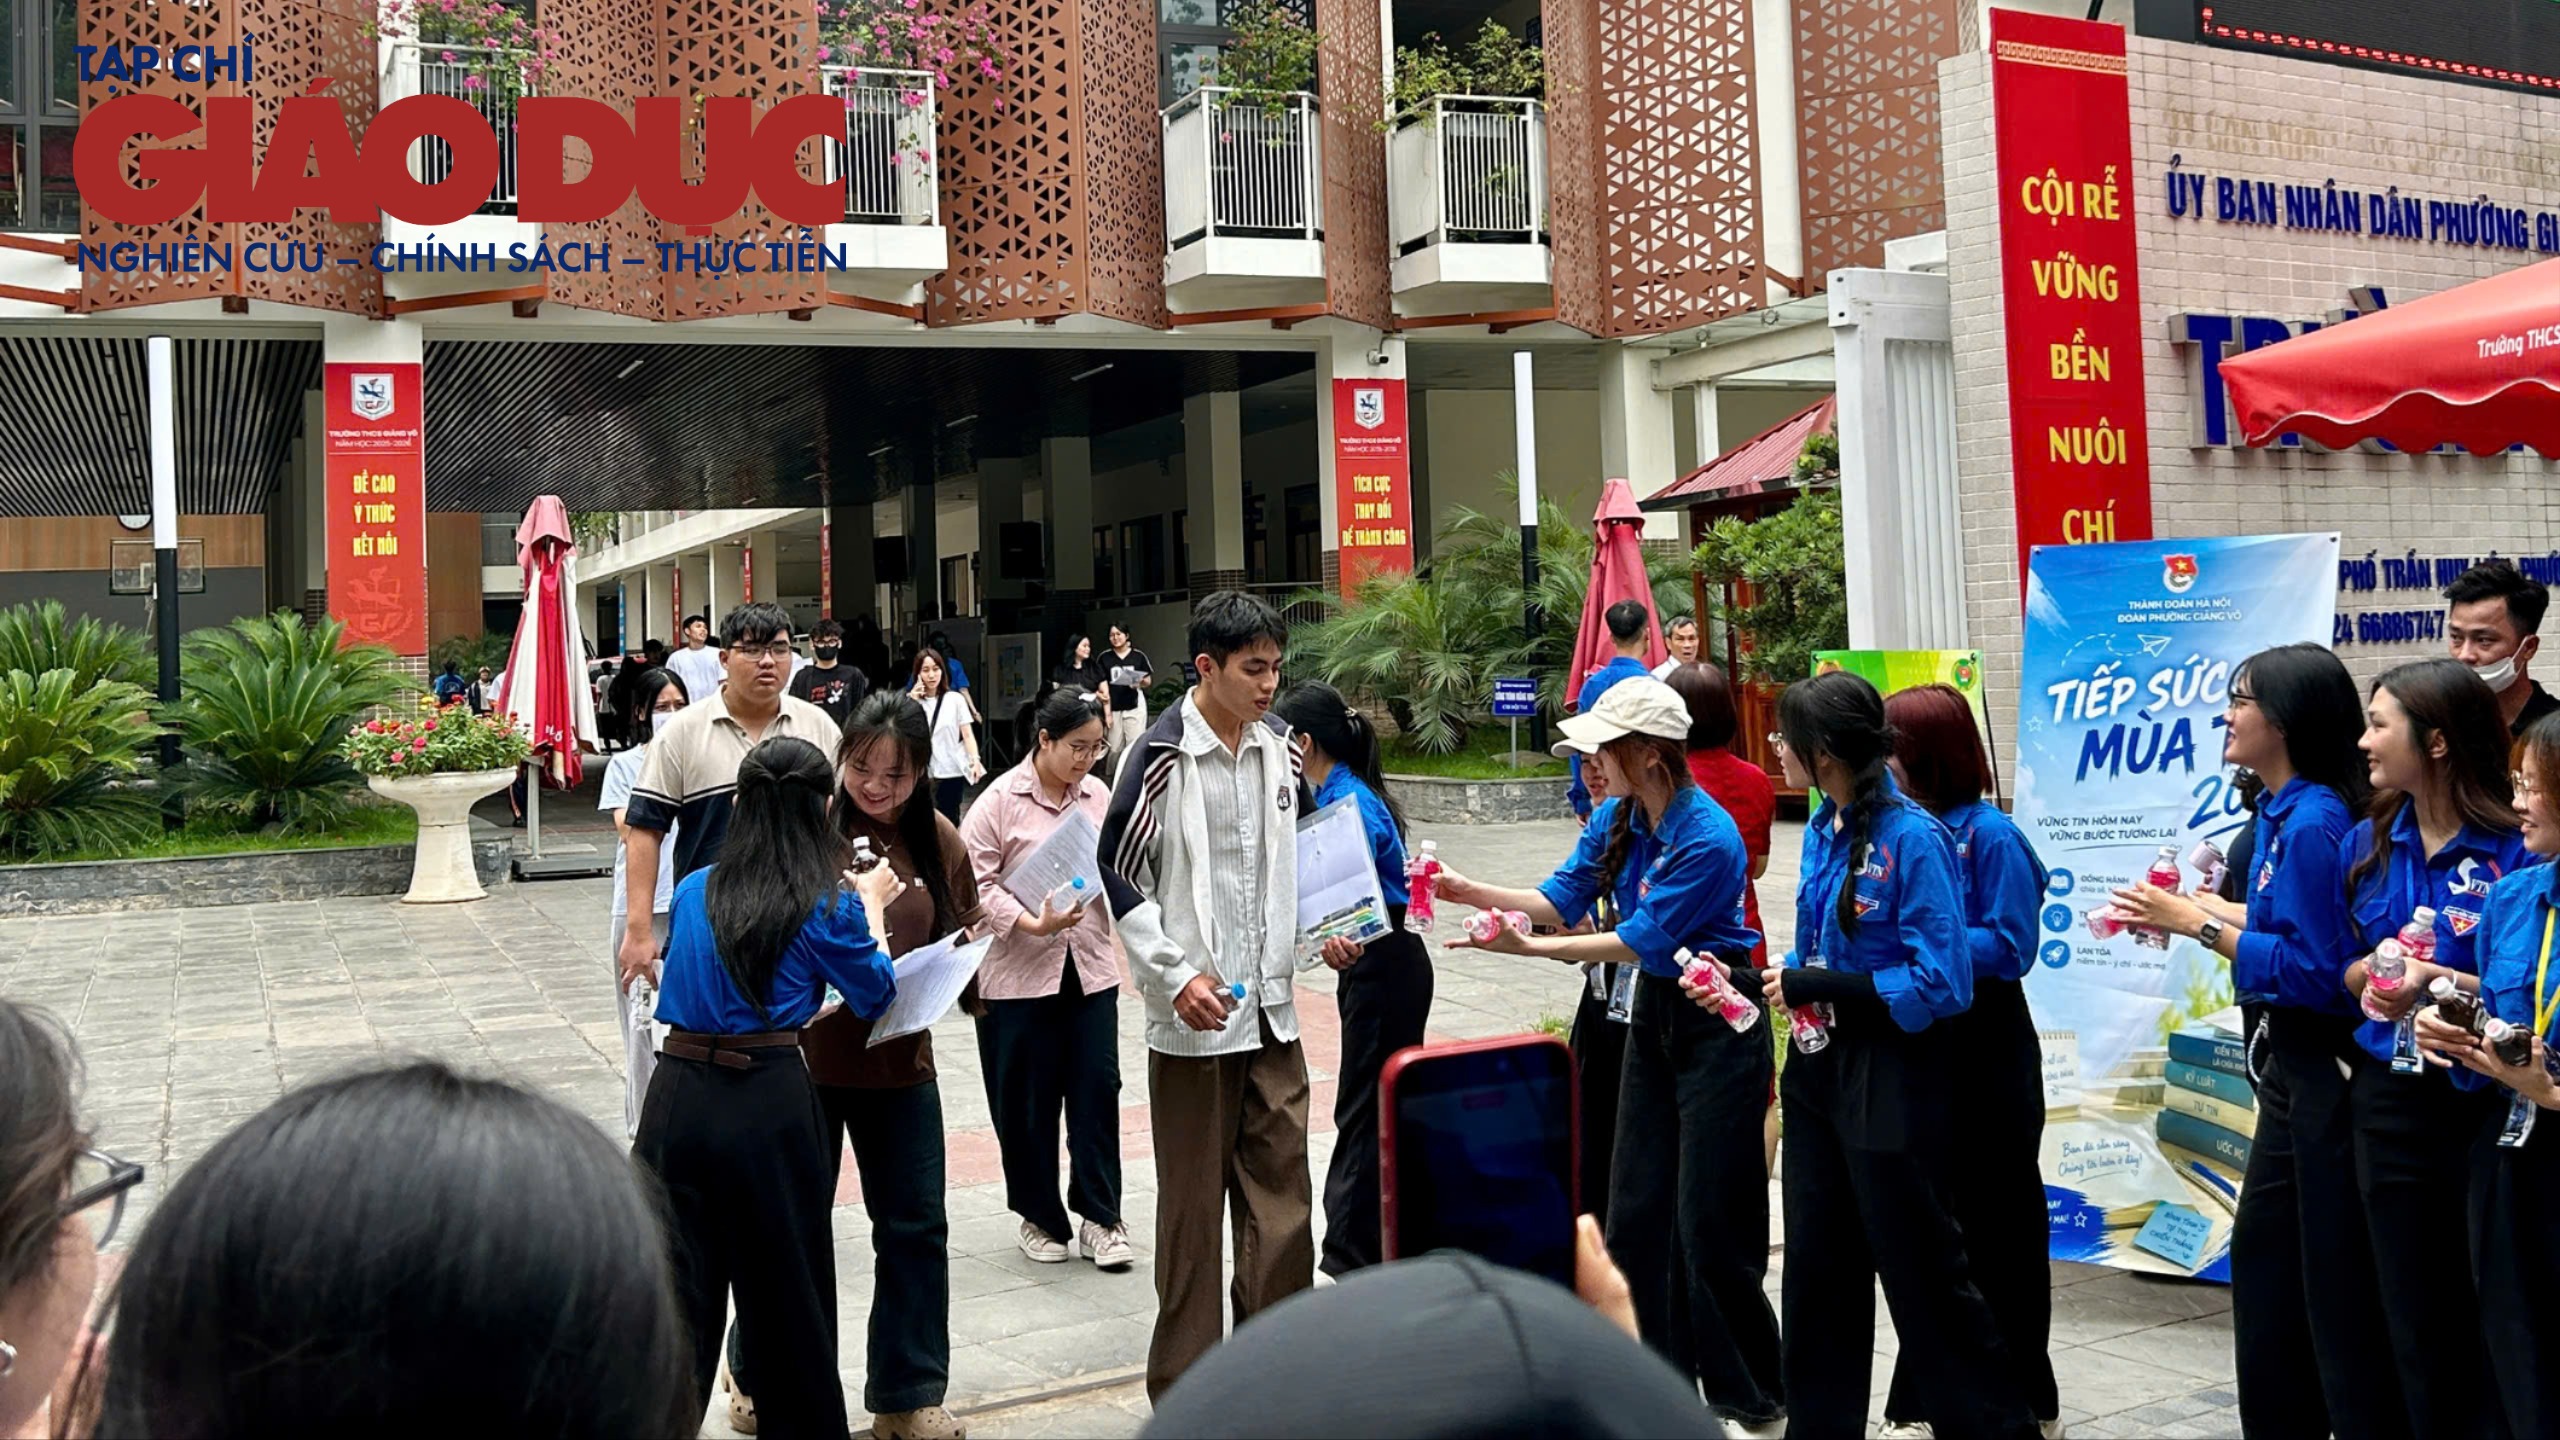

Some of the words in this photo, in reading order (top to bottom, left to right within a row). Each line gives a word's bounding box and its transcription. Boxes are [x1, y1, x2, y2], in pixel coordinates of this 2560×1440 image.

[2021, 167, 2075, 227] CỘI
[2082, 165, 2121, 221] RỄ
[2166, 153, 2206, 218] ỦY
[2215, 176, 2278, 225] BAN
[2283, 178, 2362, 233] NHÂN
[2368, 185, 2423, 240] DÂN
[2428, 194, 2529, 249] PHƯỜNG
[2031, 250, 2119, 302] VỮNG
[2049, 327, 2111, 382] BỀN
[2476, 333, 2525, 359] Trường
[2526, 323, 2560, 350] THCS
[2048, 416, 2127, 465] NUÔI
[353, 469, 369, 494] ĐỀ
[371, 475, 396, 494] CAO
[1353, 474, 1372, 493] TÍCH
[1374, 475, 1391, 496] CỰC
[354, 501, 363, 524] Ý
[365, 501, 396, 524] THỨC
[1354, 503, 1376, 520] THAY
[2062, 498, 2116, 545] CHÍ
[353, 531, 374, 557] KẾT
[377, 530, 398, 555] NỐI
[1355, 527, 1382, 546] THÀNH
[1383, 527, 1407, 546] CÔNG
[2339, 549, 2378, 591] PHỐ
[2381, 548, 2432, 590] TRẦN
[2117, 612, 2147, 623] ĐOÀN
[2148, 610, 2192, 622] PHƯỜNG
[2193, 610, 2225, 621] GIẢNG
[2226, 609, 2242, 620] VÕ
[2128, 598, 2163, 610] THÀNH
[2164, 597, 2194, 609] ĐOÀN
[2195, 597, 2211, 608] HÀ
[2212, 596, 2232, 610] NỘI
[2358, 610, 2445, 643] 66886747
[2047, 660, 2137, 724] TIẾP
[2146, 653, 2230, 714] SỨC
[2075, 709, 2197, 786] MÙA
[2187, 774, 2245, 830] 20
[2037, 815, 2069, 827] VỮNG
[2071, 817, 2089, 826] TIN
[2092, 815, 2118, 826] HÔM
[2120, 814, 2144, 825] NAY
[2049, 829, 2081, 841] VỮNG
[2083, 828, 2115, 840] BƯỚC
[2118, 828, 2157, 839] TƯƠNG
[2159, 828, 2178, 838] LAI
